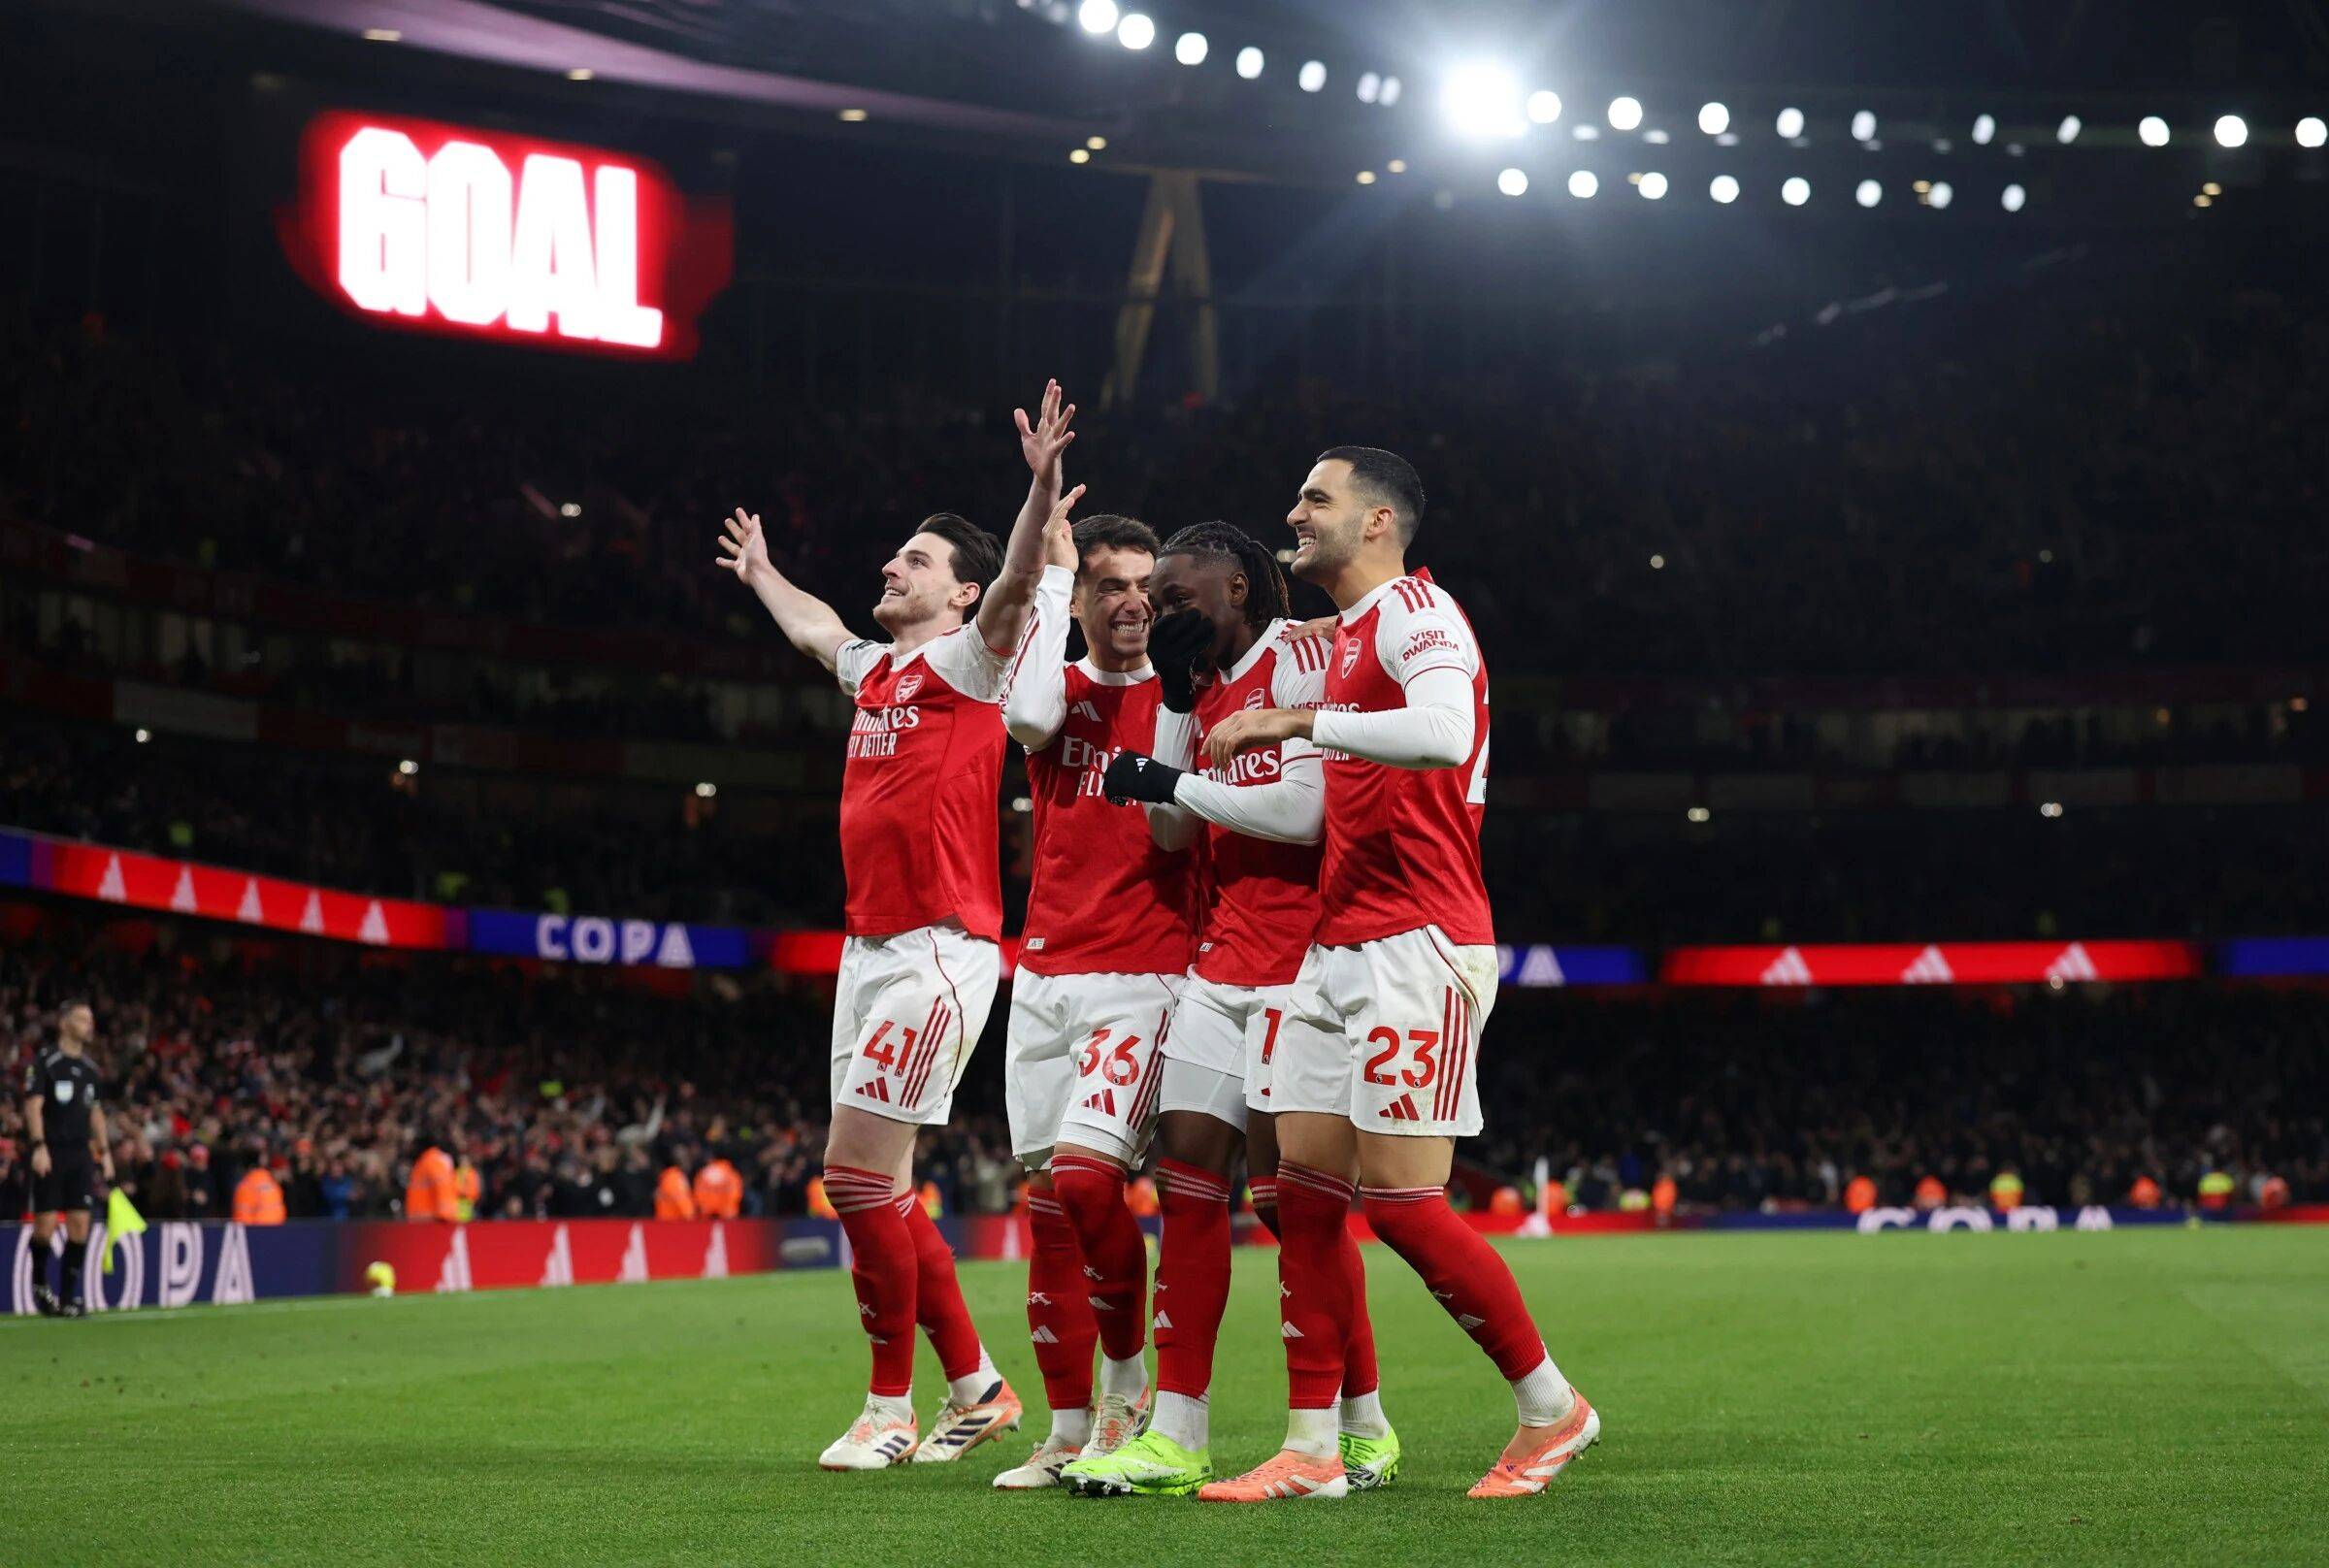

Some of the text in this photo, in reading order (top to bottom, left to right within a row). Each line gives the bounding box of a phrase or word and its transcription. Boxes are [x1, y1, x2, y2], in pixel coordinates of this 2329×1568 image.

[339, 126, 663, 347] GOAL
[1410, 630, 1445, 642] VISIT
[860, 733, 898, 758] BETTER
[536, 913, 695, 968] COPA
[863, 1021, 917, 1077] 41
[1079, 1029, 1141, 1087] 36
[1363, 1026, 1439, 1088] 23
